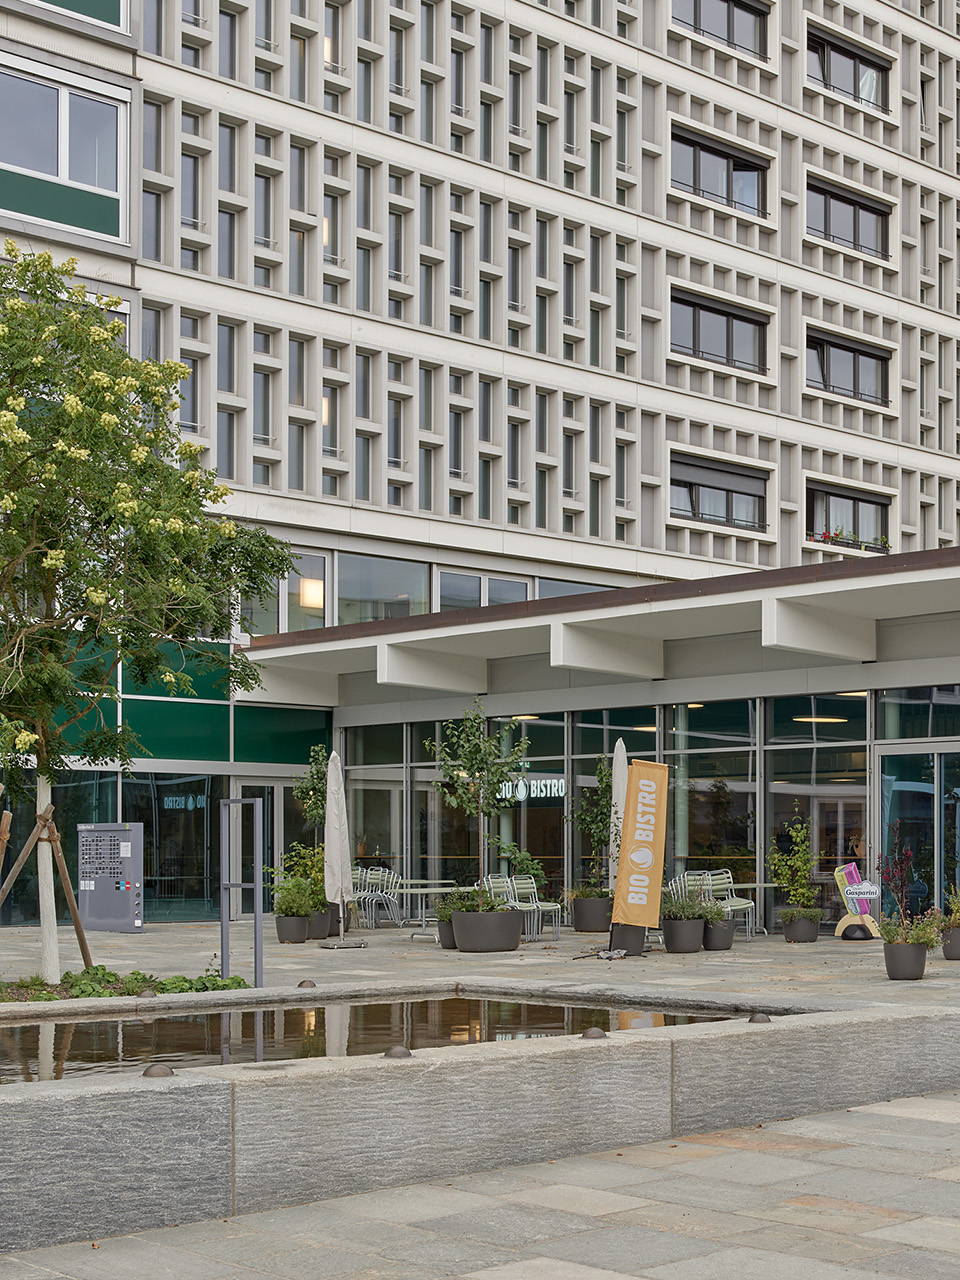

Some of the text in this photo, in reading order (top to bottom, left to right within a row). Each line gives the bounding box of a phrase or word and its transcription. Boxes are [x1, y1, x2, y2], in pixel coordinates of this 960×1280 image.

[530, 779, 565, 797] BISTRO
[627, 779, 657, 905] BIO BISTRO
[846, 889, 877, 897] Gasparini
